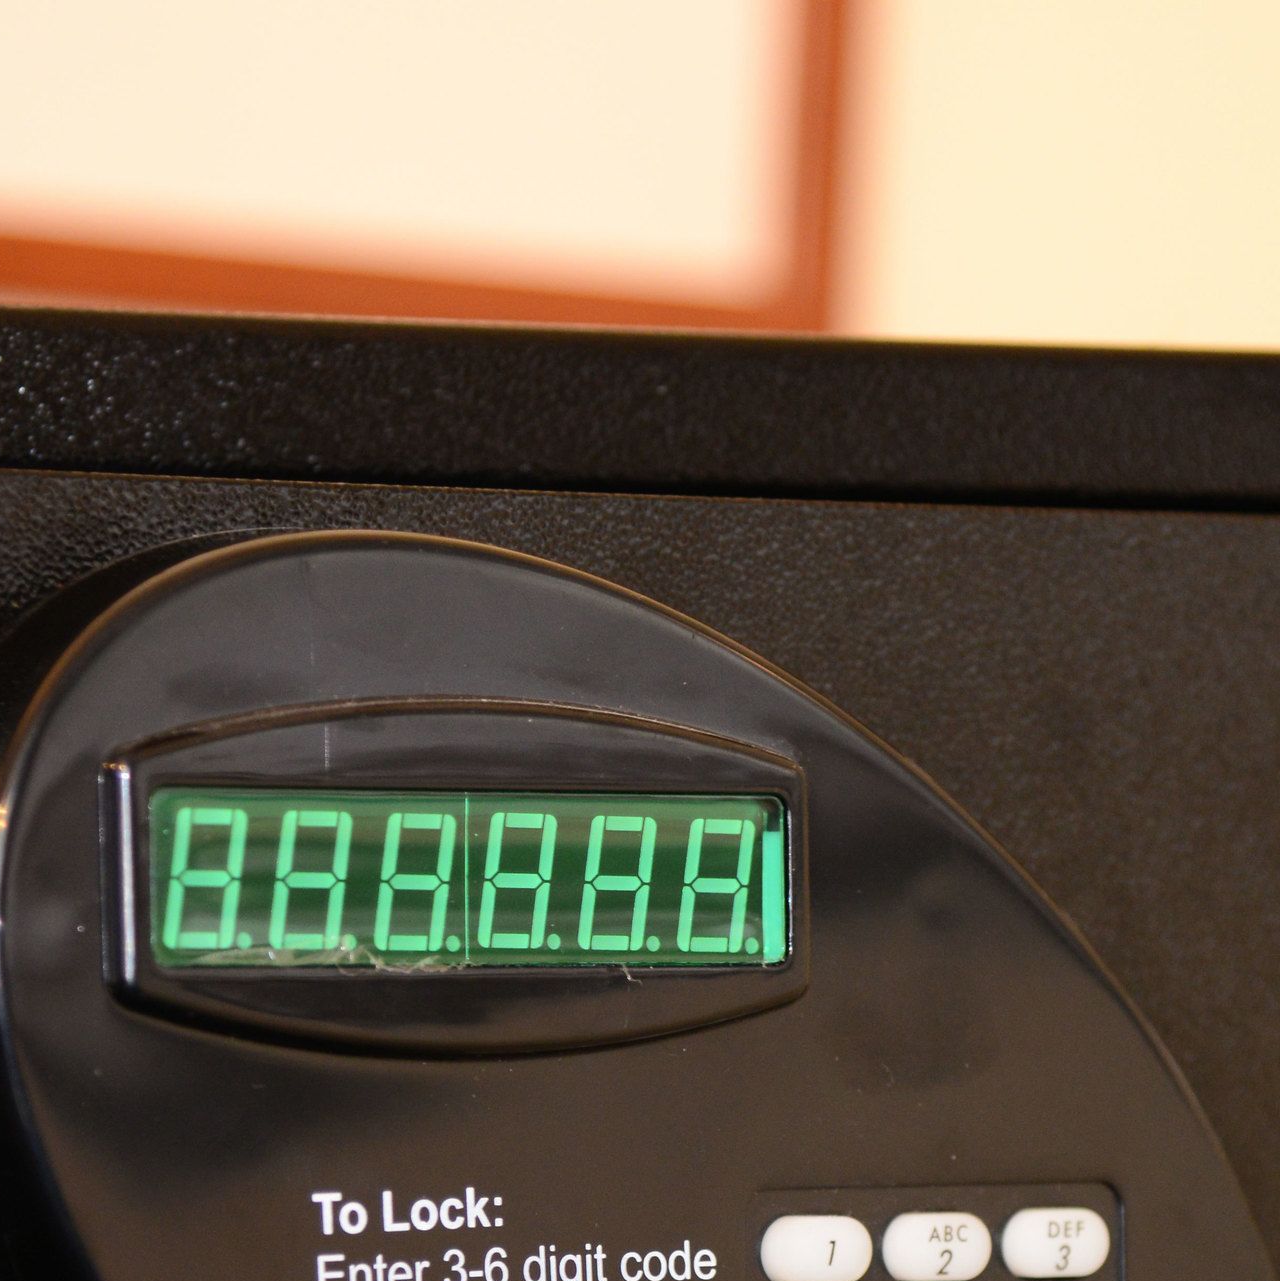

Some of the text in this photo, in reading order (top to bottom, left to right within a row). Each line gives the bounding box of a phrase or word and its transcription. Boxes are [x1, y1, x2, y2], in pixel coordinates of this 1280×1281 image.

[311, 1186, 504, 1236] To Lock:
[928, 1224, 969, 1244] ABC
[1046, 1219, 1086, 1240] DEF
[825, 1239, 837, 1267] 1
[936, 1249, 953, 1276] 2
[1055, 1244, 1072, 1273] 3
